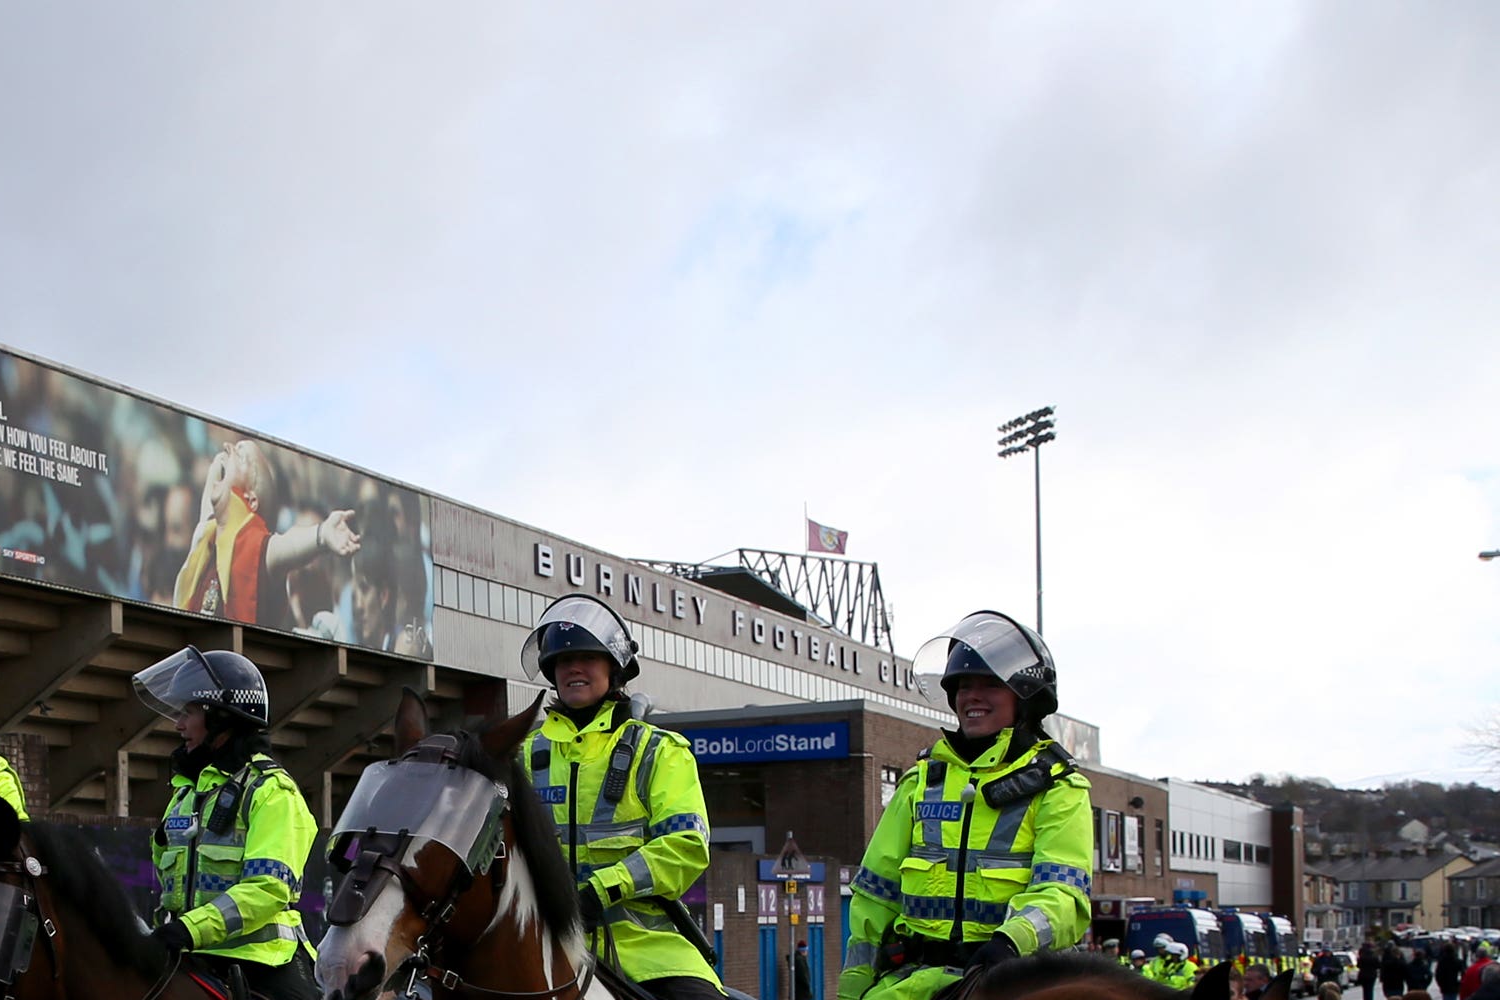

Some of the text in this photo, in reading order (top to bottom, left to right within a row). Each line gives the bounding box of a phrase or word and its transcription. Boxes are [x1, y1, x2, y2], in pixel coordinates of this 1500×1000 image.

[4, 448, 17, 470] WE
[19, 452, 39, 475] FEEL
[39, 458, 56, 480] THE
[57, 464, 82, 487] SAME.
[7, 426, 27, 448] HOW
[29, 432, 47, 454] YOU
[49, 438, 69, 461] FEEL
[70, 445, 97, 469] ABOUT
[98, 453, 108, 475] IT,
[534, 543, 707, 625] BURNLEY
[732, 609, 863, 675] FOOTBALL
[695, 732, 836, 755] BobLordStand
[916, 803, 959, 820] POLICE
